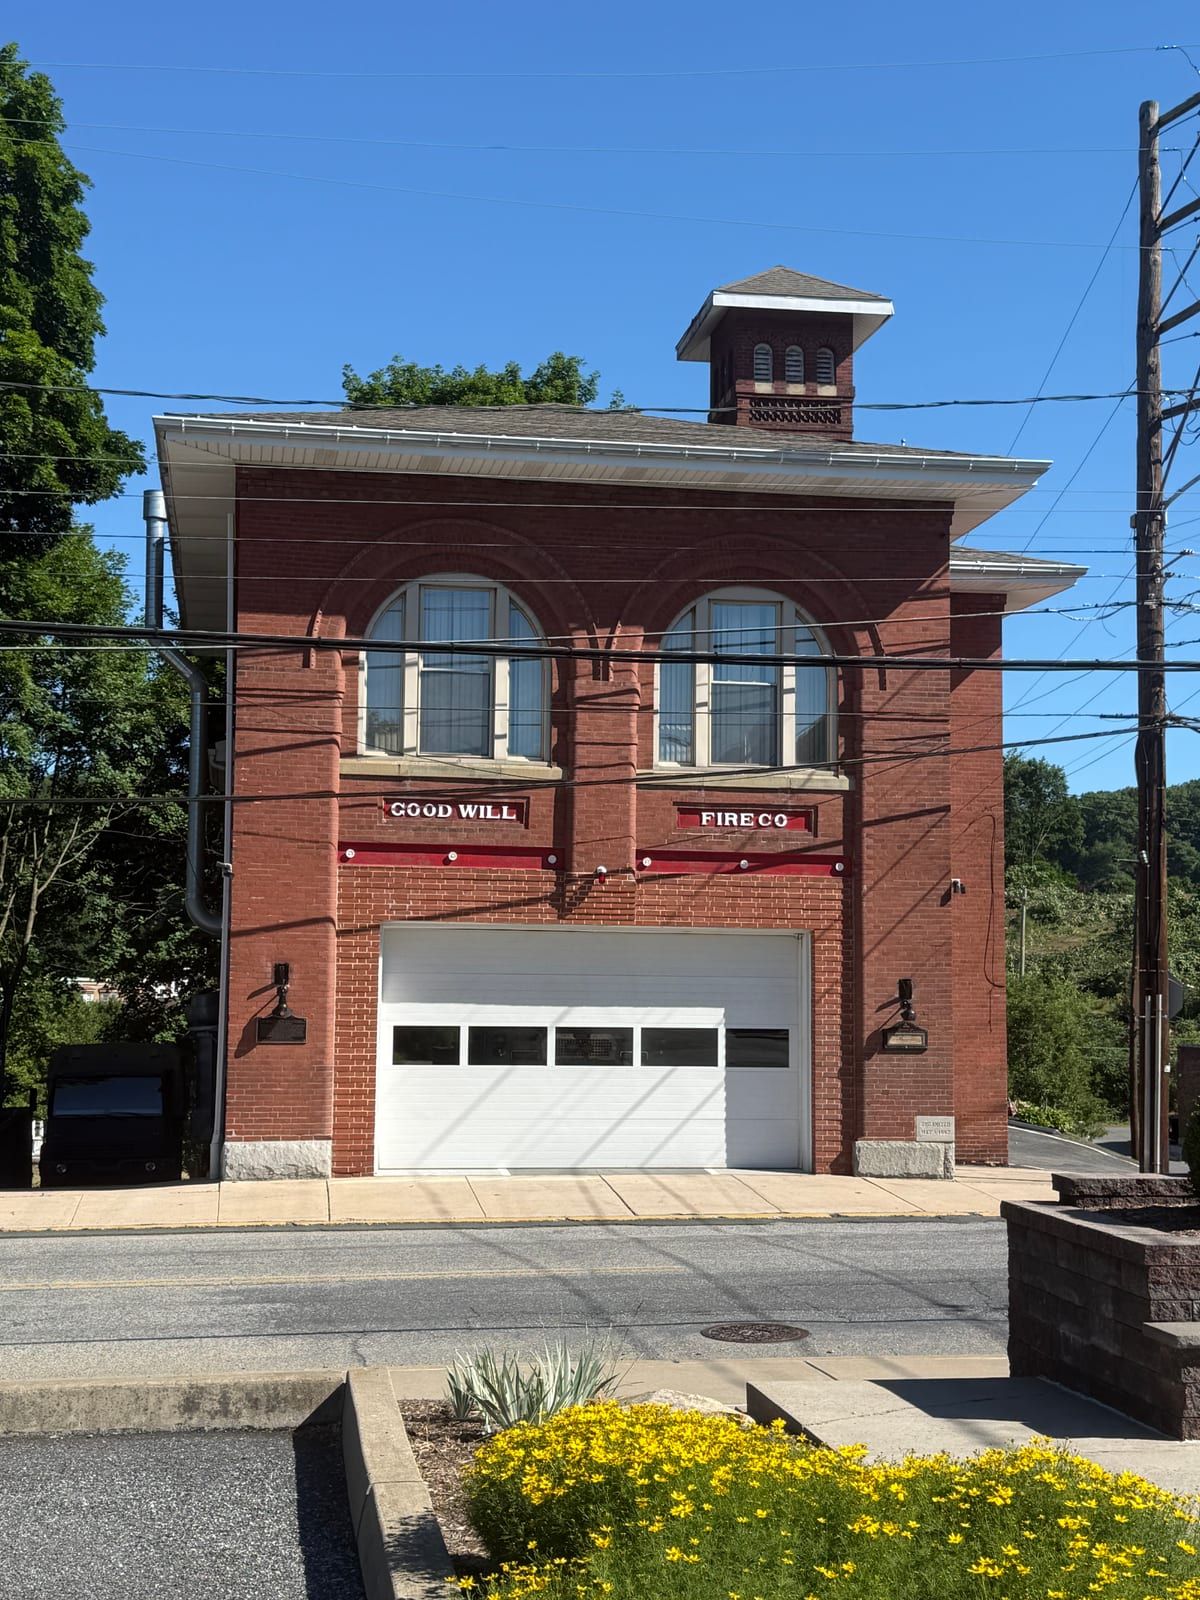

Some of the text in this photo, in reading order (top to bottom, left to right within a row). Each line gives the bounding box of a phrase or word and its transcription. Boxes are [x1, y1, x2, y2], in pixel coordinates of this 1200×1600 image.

[391, 802, 516, 819] GOOD WILL
[701, 812, 787, 827] FIRE CO
